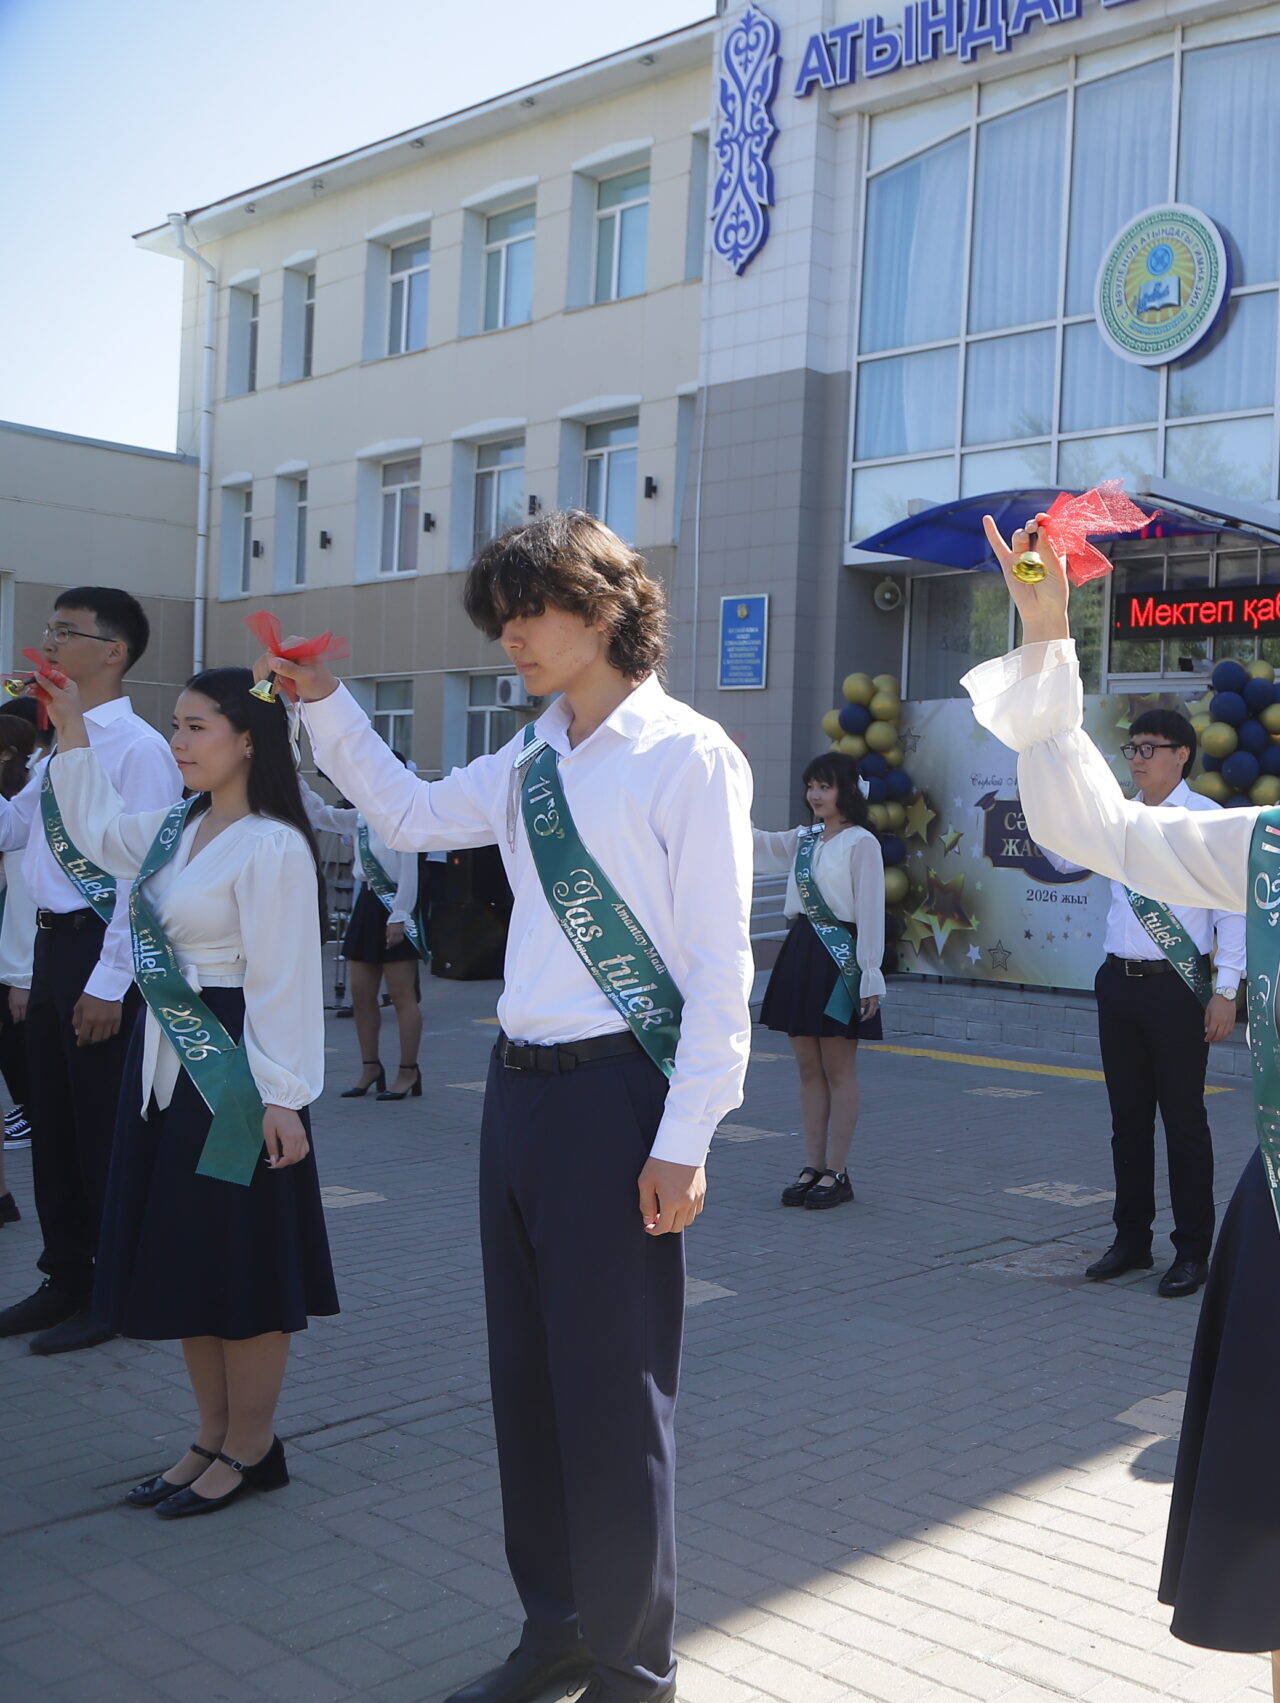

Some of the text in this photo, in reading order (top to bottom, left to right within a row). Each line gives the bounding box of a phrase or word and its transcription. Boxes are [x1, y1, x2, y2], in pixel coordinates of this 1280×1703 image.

[1130, 596, 1234, 628] Мектеп
[1026, 889, 1088, 905] 2026 жыл
[159, 1002, 222, 1062] 2026
